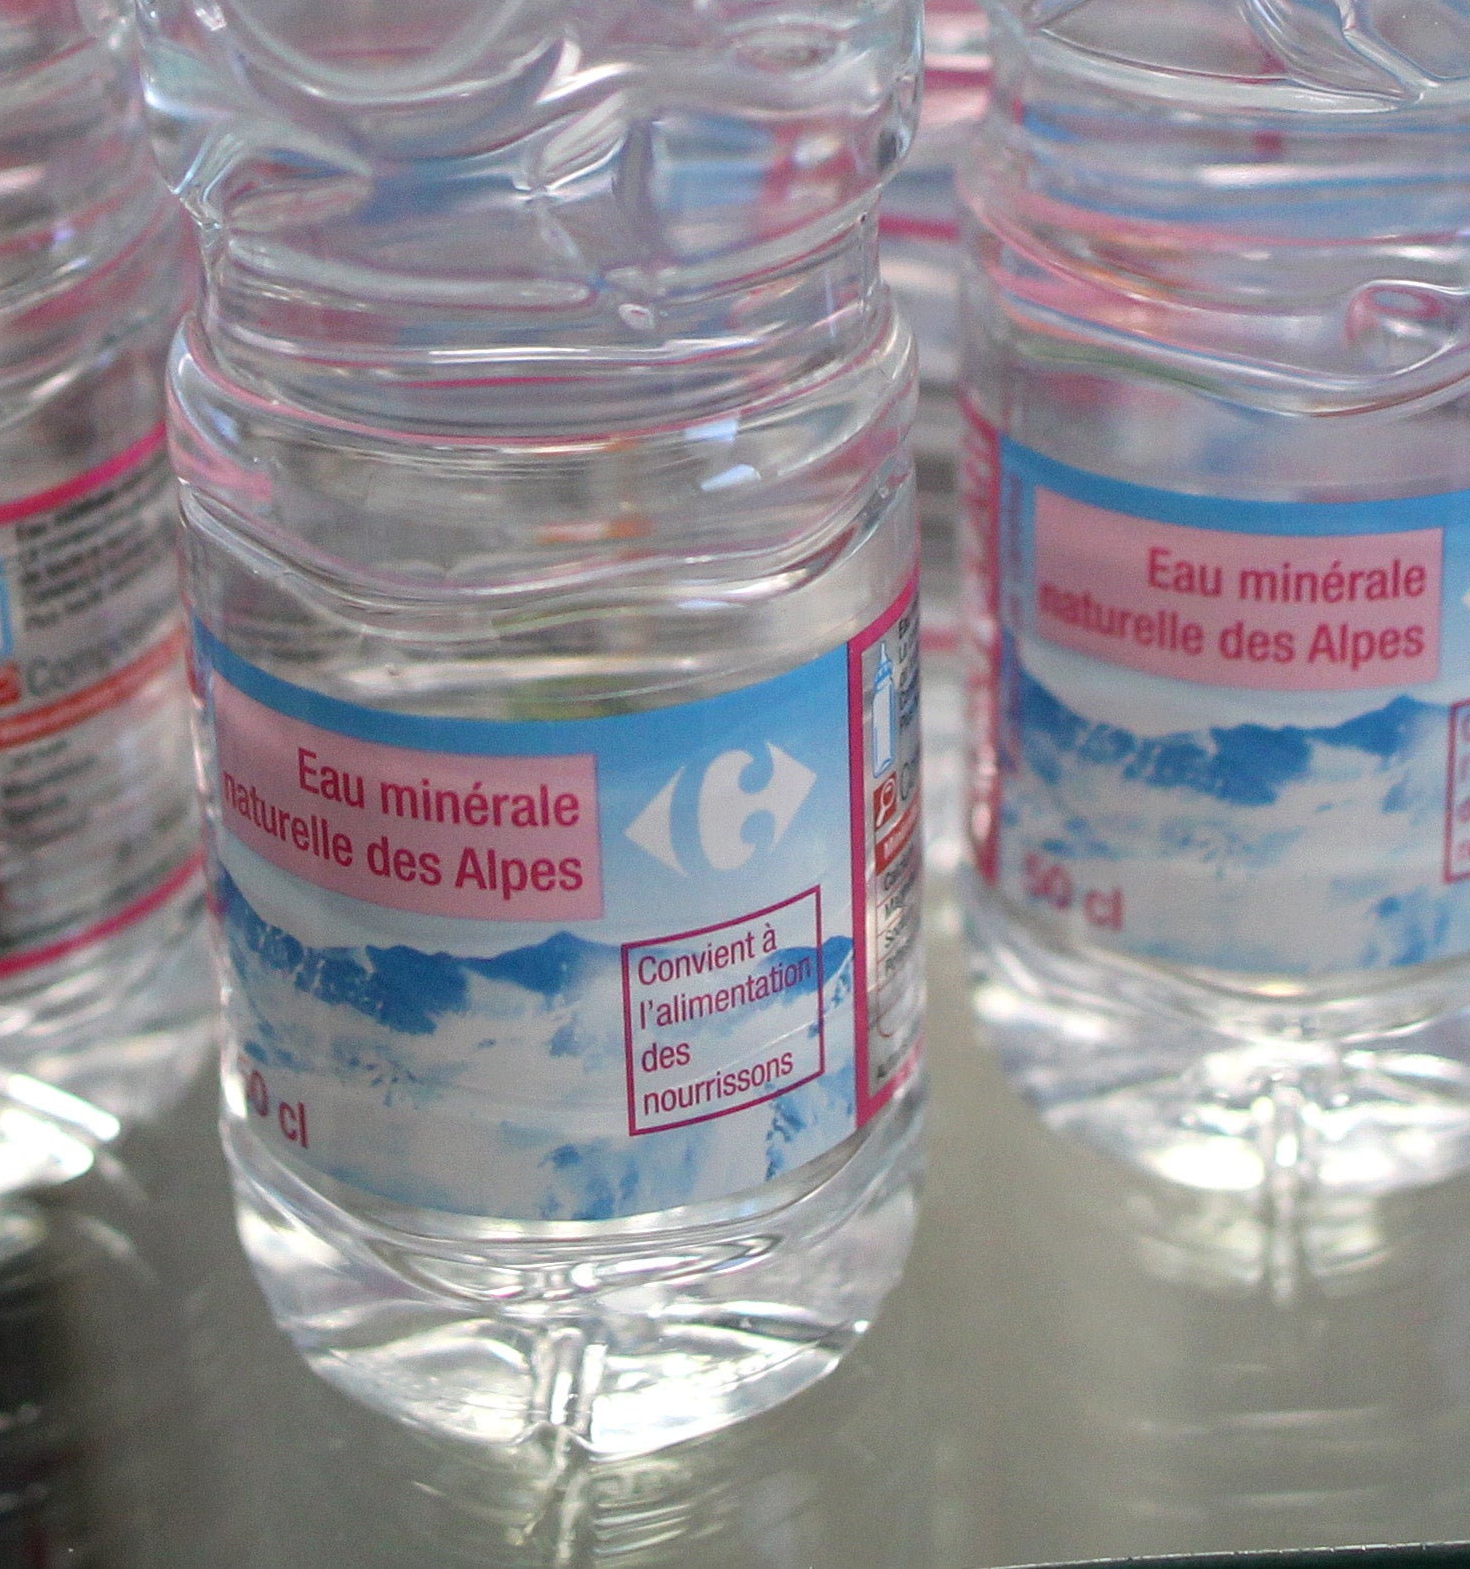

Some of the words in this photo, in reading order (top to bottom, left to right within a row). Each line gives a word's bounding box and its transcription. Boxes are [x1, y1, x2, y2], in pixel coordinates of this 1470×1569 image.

[1146, 545, 1222, 598] Eau
[1238, 558, 1428, 605] minérale
[1037, 582, 1205, 656] naturelle
[1219, 617, 1297, 664] des
[1308, 623, 1426, 672] Alpes
[298, 747, 366, 810] Eau
[379, 779, 580, 828] minérale
[223, 769, 354, 868] naturelle
[367, 834, 442, 888] des
[455, 848, 584, 902] Alpes
[637, 930, 755, 987] Convient
[761, 922, 779, 952] à
[640, 1043, 692, 1074] des
[642, 1050, 795, 1117] nourrissons
[279, 1102, 309, 1150] cl
